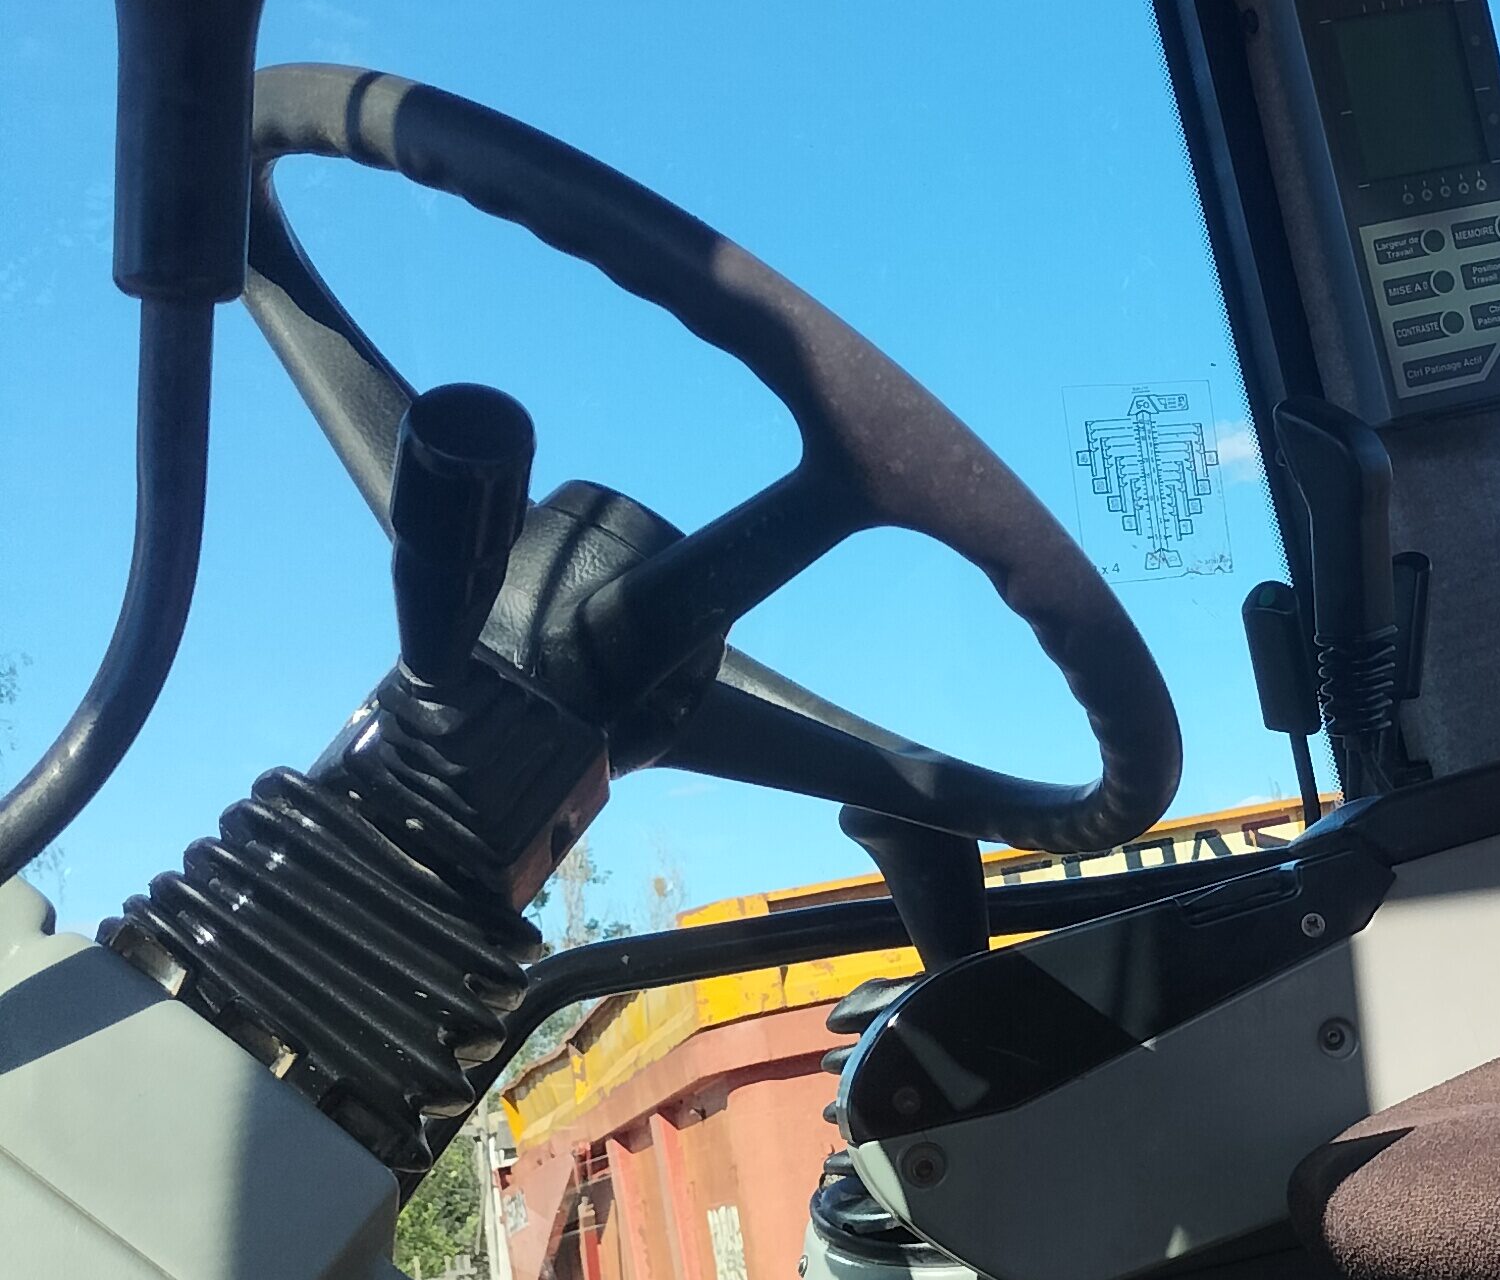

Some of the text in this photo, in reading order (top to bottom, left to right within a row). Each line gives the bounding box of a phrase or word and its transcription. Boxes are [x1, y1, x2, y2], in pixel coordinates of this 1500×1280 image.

[1454, 227, 1495, 241] MEMOIRE
[1376, 236, 1419, 251] Largeur de
[1386, 248, 1414, 259] Travail
[1388, 284, 1412, 297] MISE
[1414, 282, 1422, 292] A
[1396, 321, 1440, 339] CONTRASTE
[1406, 355, 1483, 379] Ctrl Patinage Actif
[1112, 562, 1120, 573] 4
